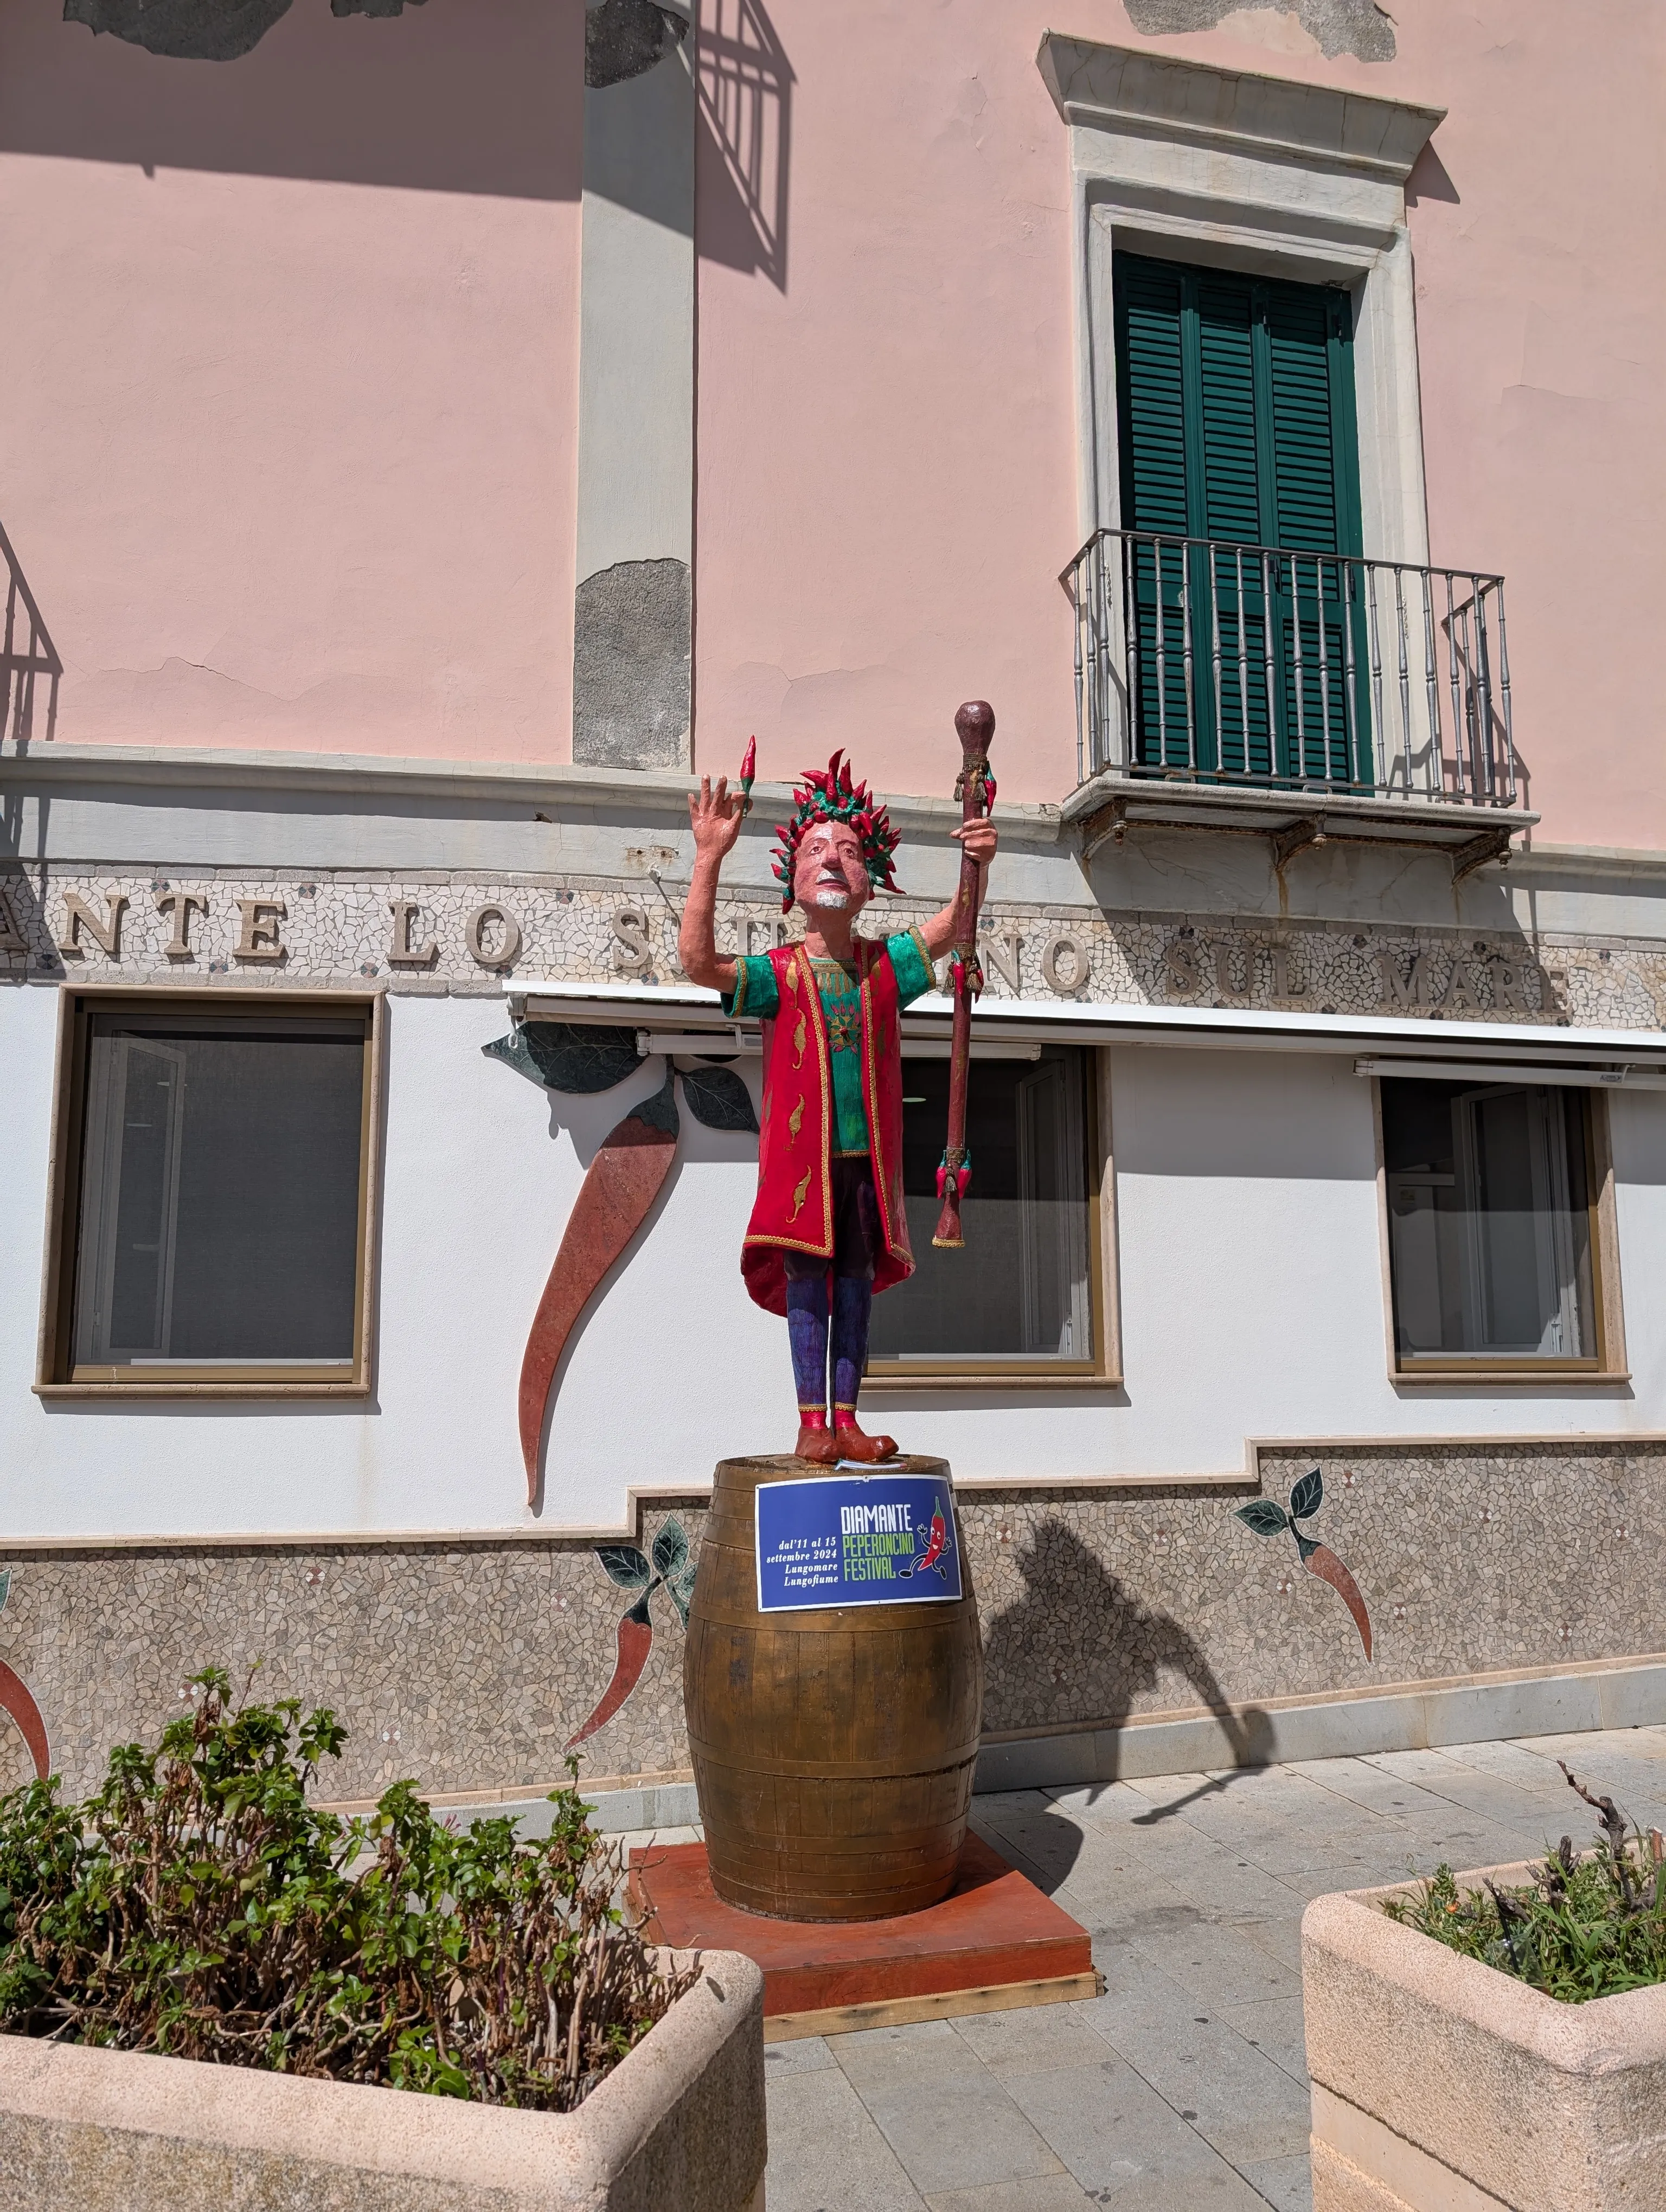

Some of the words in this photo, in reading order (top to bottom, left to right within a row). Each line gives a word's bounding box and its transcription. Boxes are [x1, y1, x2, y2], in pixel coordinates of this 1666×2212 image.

[387, 901, 520, 965] LO
[1167, 941, 1311, 1002] SUL
[1375, 951, 1573, 1017] MARE
[841, 1504, 913, 1534] DIAMANTE
[811, 1537, 821, 1547] al
[825, 1536, 836, 1547] 15
[842, 1532, 915, 1558] PEPERONCINO
[766, 1551, 810, 1564] settembre
[813, 1548, 837, 1559] 2024
[784, 1564, 838, 1576] Lungomare
[844, 1557, 896, 1581] FESTIVAL
[784, 1574, 838, 1588] Lungofiume
